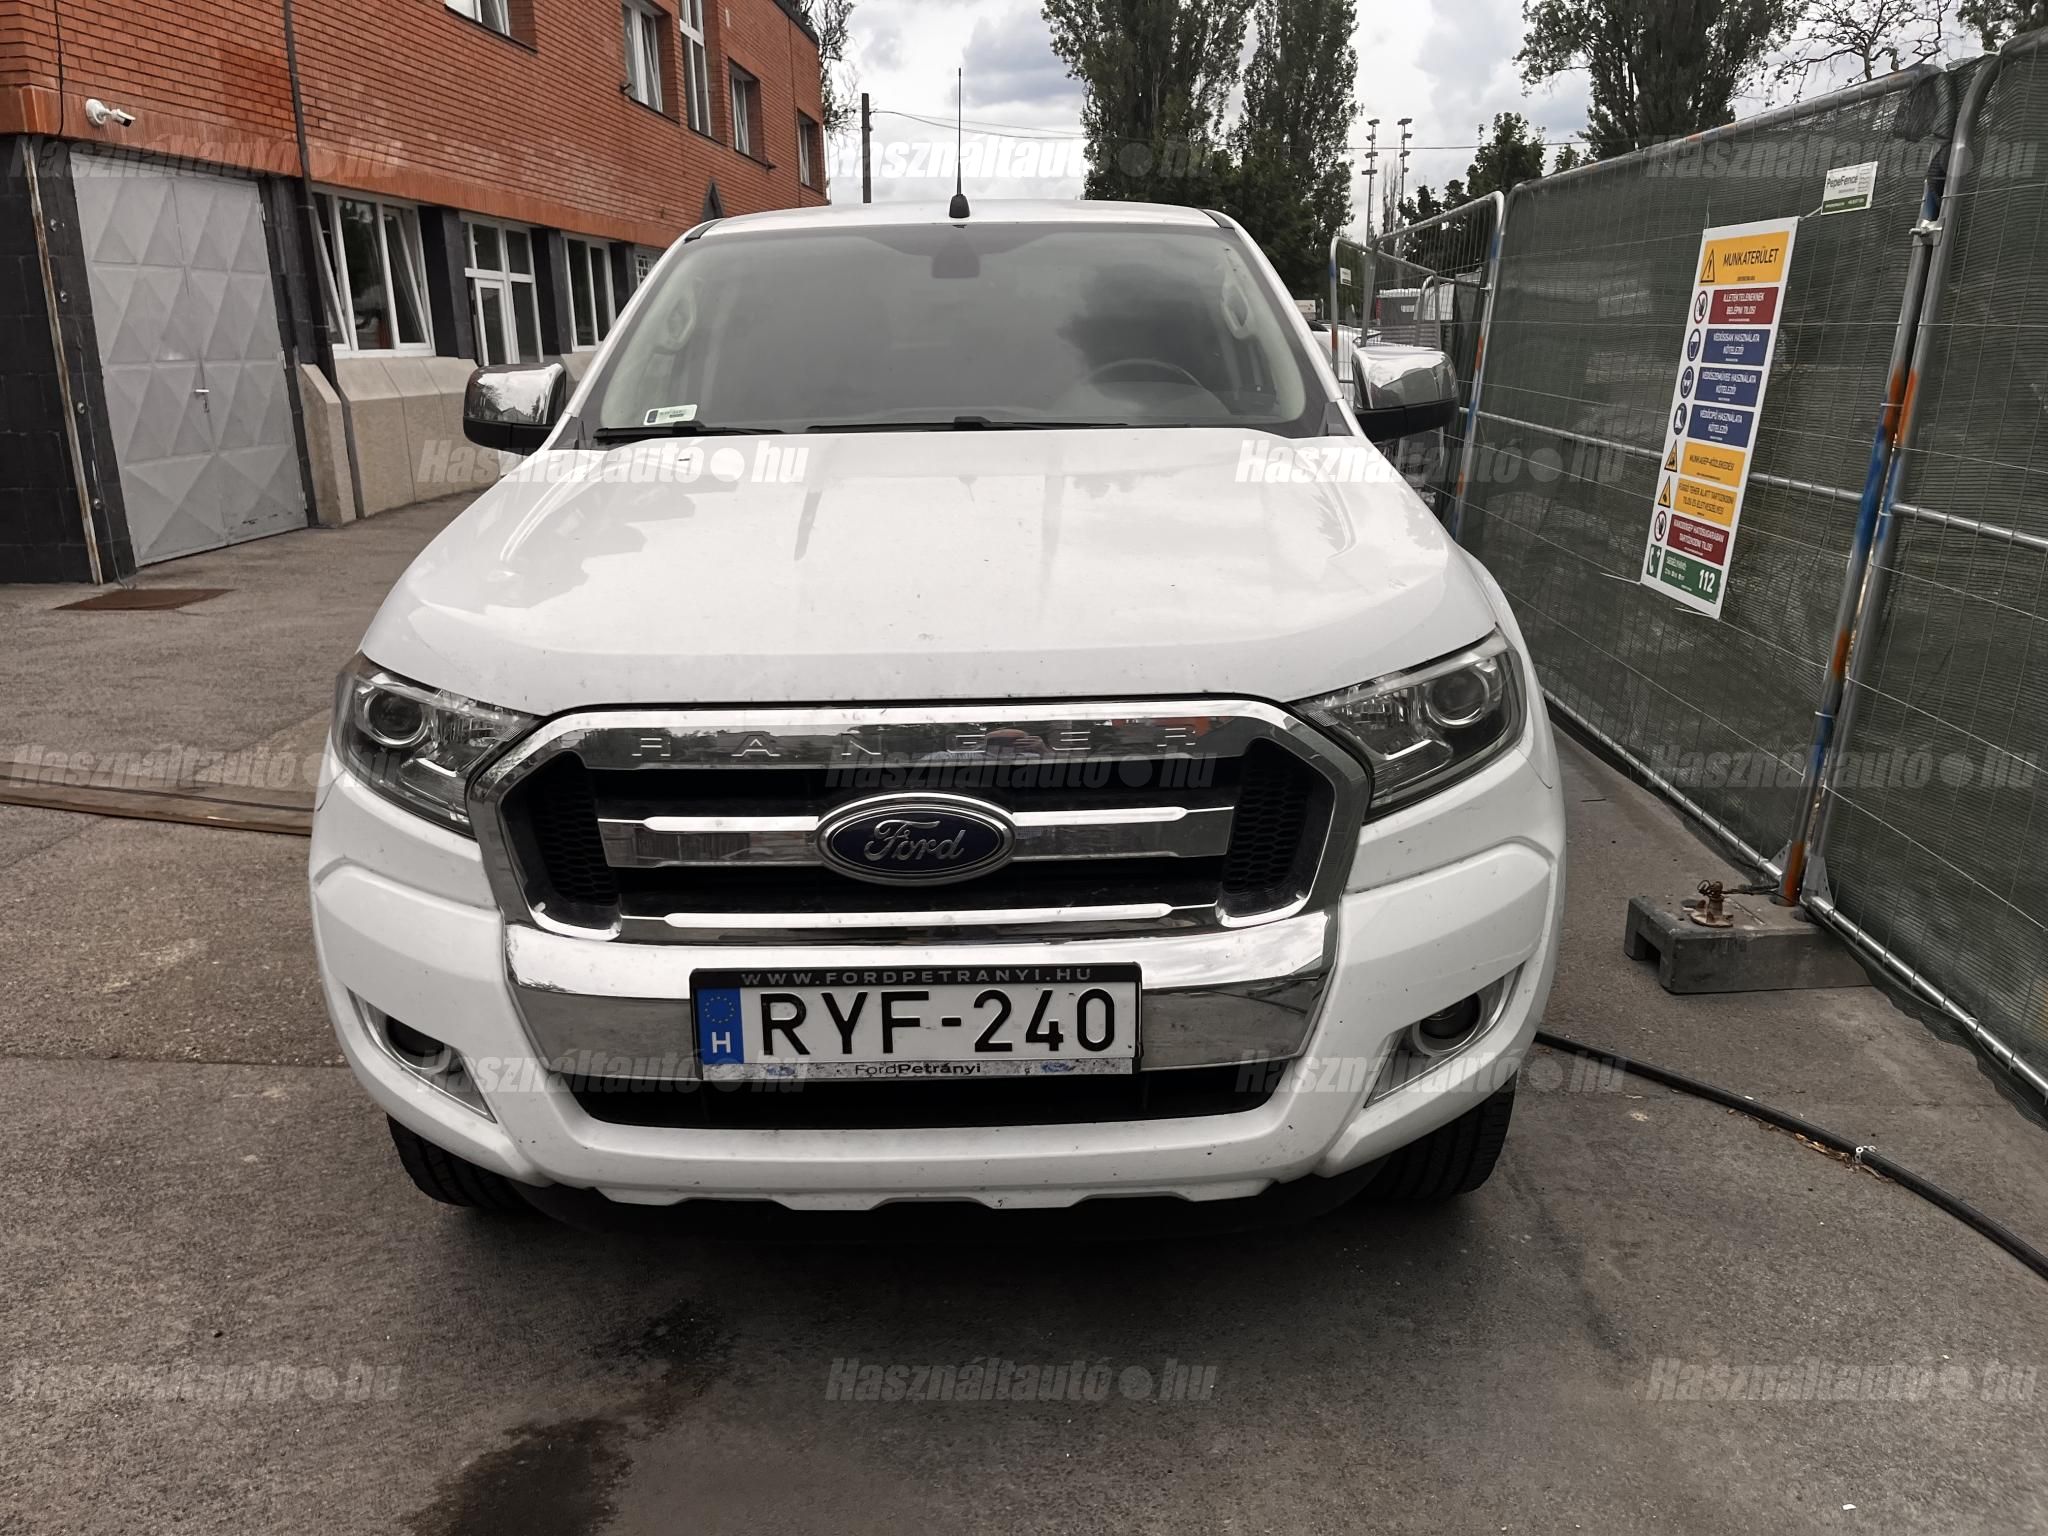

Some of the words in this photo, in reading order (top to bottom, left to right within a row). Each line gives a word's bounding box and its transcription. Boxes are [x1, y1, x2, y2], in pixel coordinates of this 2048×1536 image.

[1723, 246, 1779, 266] MUNKATERÜLET
[1698, 569, 1715, 593] 112
[864, 819, 965, 862] Ford
[741, 968, 1092, 986] WWW.FORDPETRANYI.HU
[760, 988, 1115, 1056] RYF-240
[711, 1032, 732, 1054] H
[854, 1063, 982, 1077] FordPetrányi
